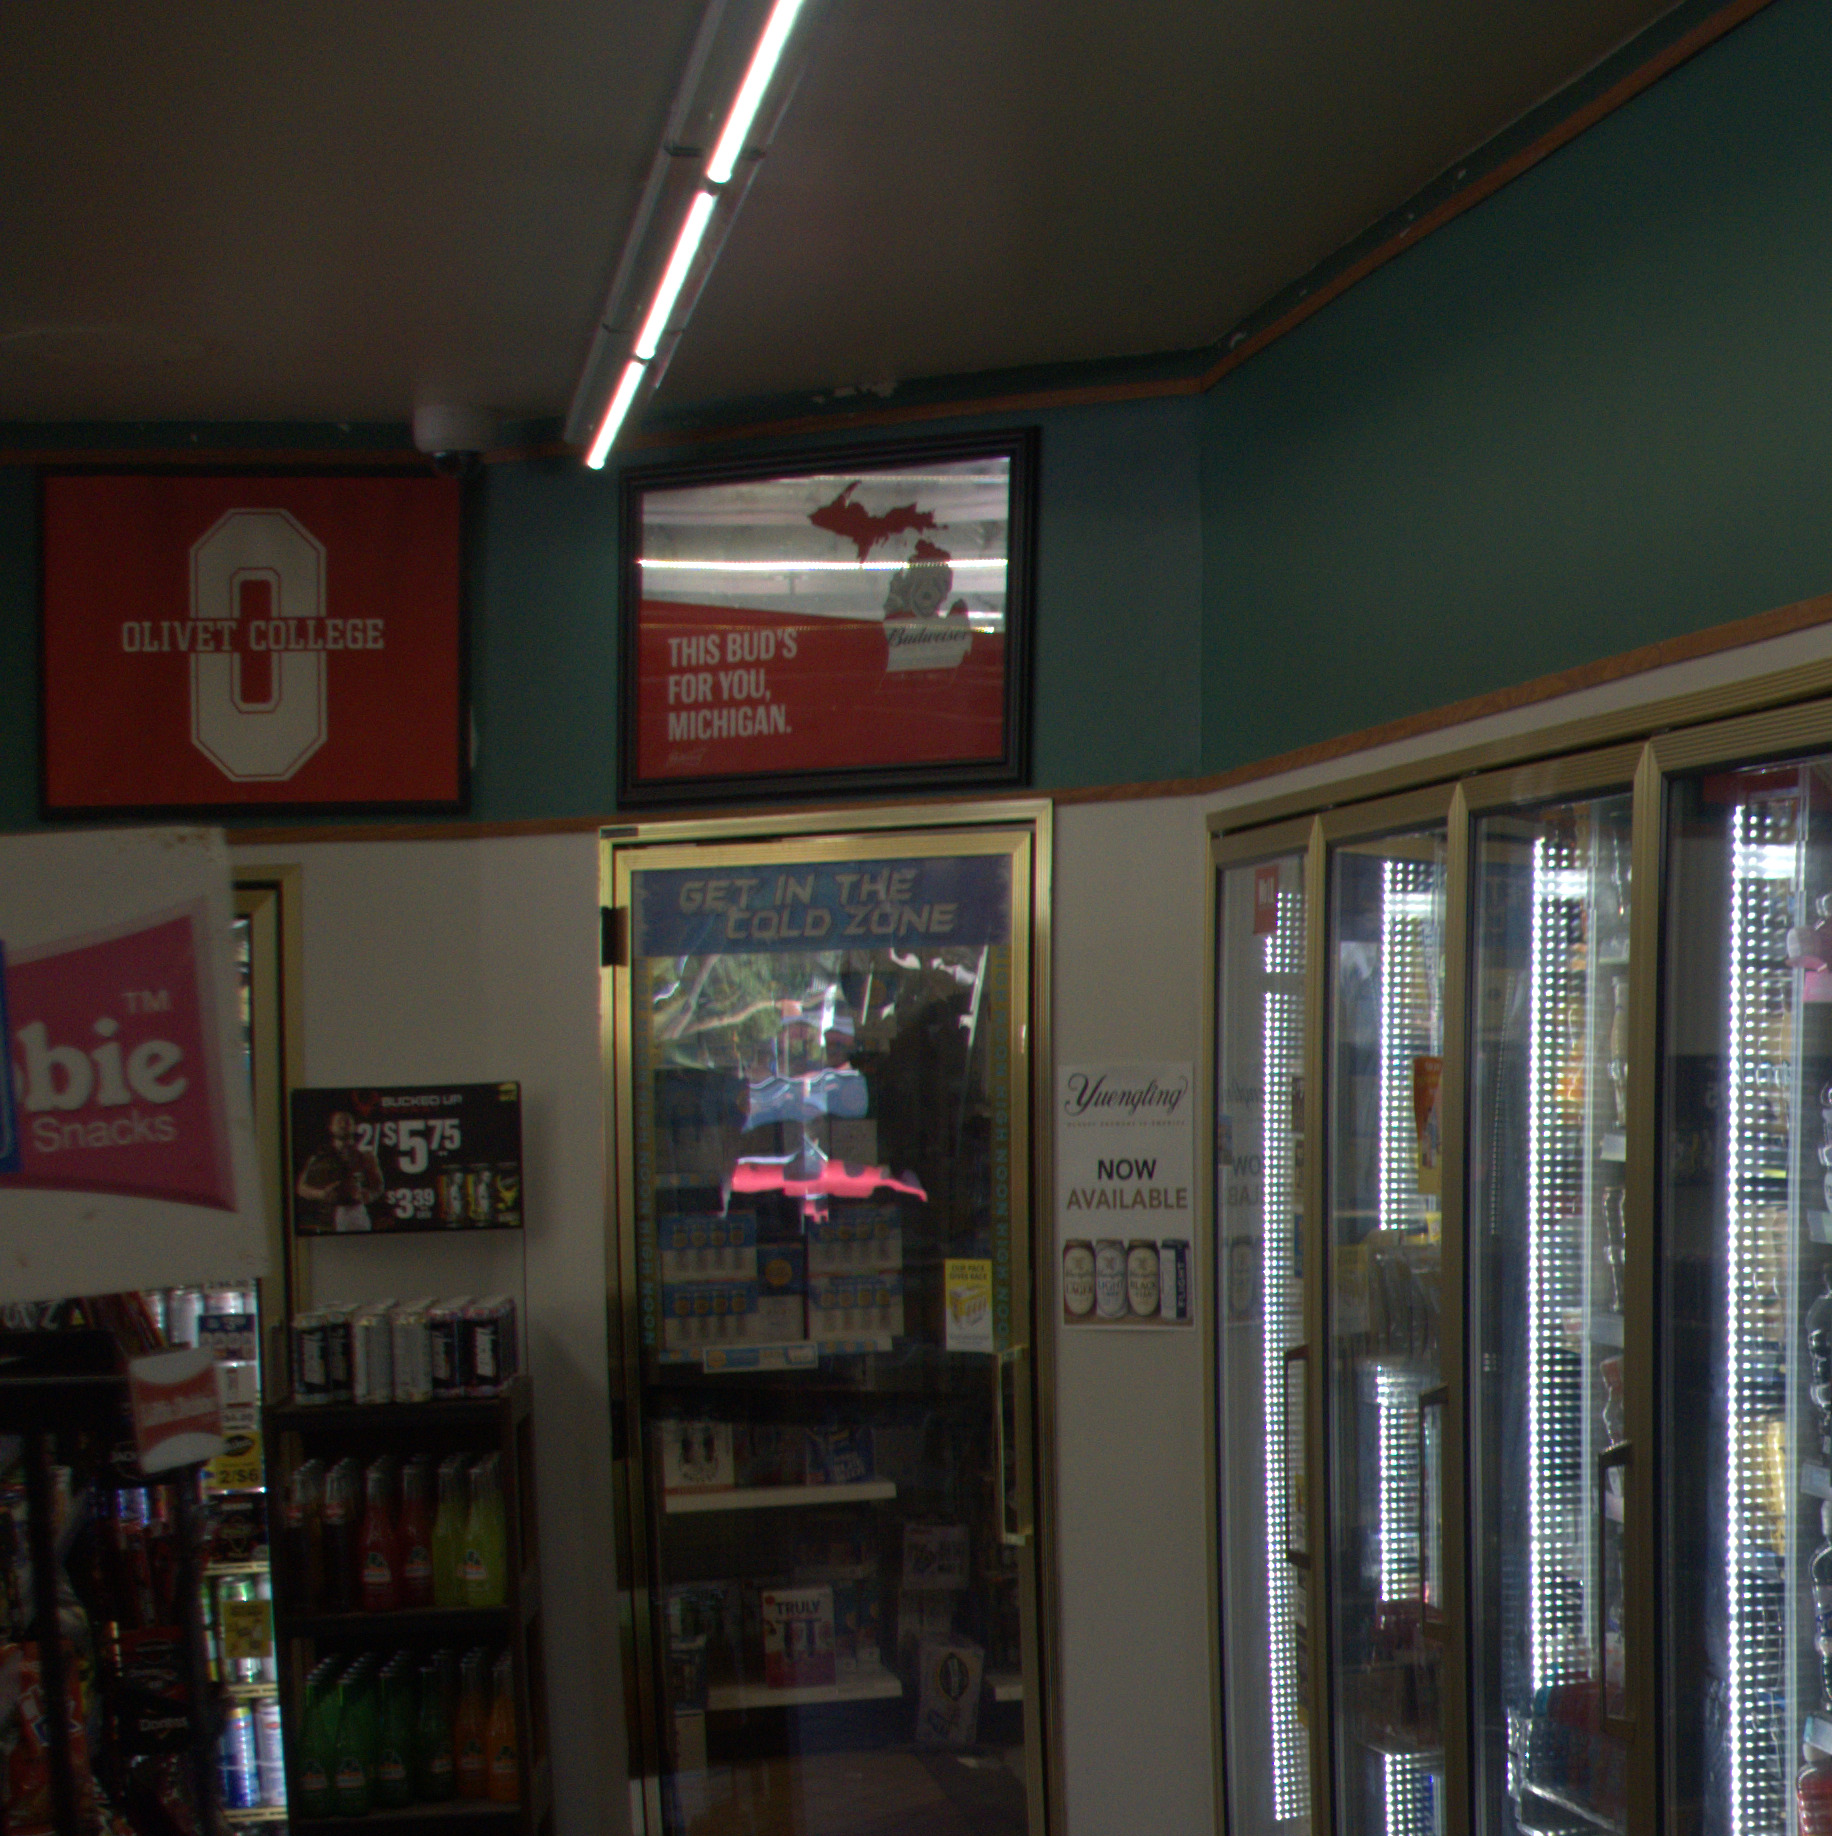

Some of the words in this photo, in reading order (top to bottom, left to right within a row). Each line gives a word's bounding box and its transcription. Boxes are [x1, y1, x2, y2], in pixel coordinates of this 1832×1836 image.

[122, 620, 237, 652] OLIVET
[249, 619, 385, 651] COLLEGE
[668, 636, 720, 667] THIS
[727, 629, 798, 663] BUD'S
[668, 671, 713, 705] FOR
[719, 669, 771, 702] YOU,
[668, 704, 792, 741] MICHIGAN.
[679, 879, 756, 913] GET
[776, 875, 815, 904] IN
[835, 869, 917, 901] THE
[728, 906, 832, 939] COLD
[844, 903, 959, 936] ZONE
[14, 1018, 187, 1112] bie
[1064, 1073, 1188, 1116] Yuengling
[33, 1109, 178, 1153] Snacks
[1098, 1159, 1157, 1180] NOW
[1066, 1188, 1188, 1210] AVAILABLE
